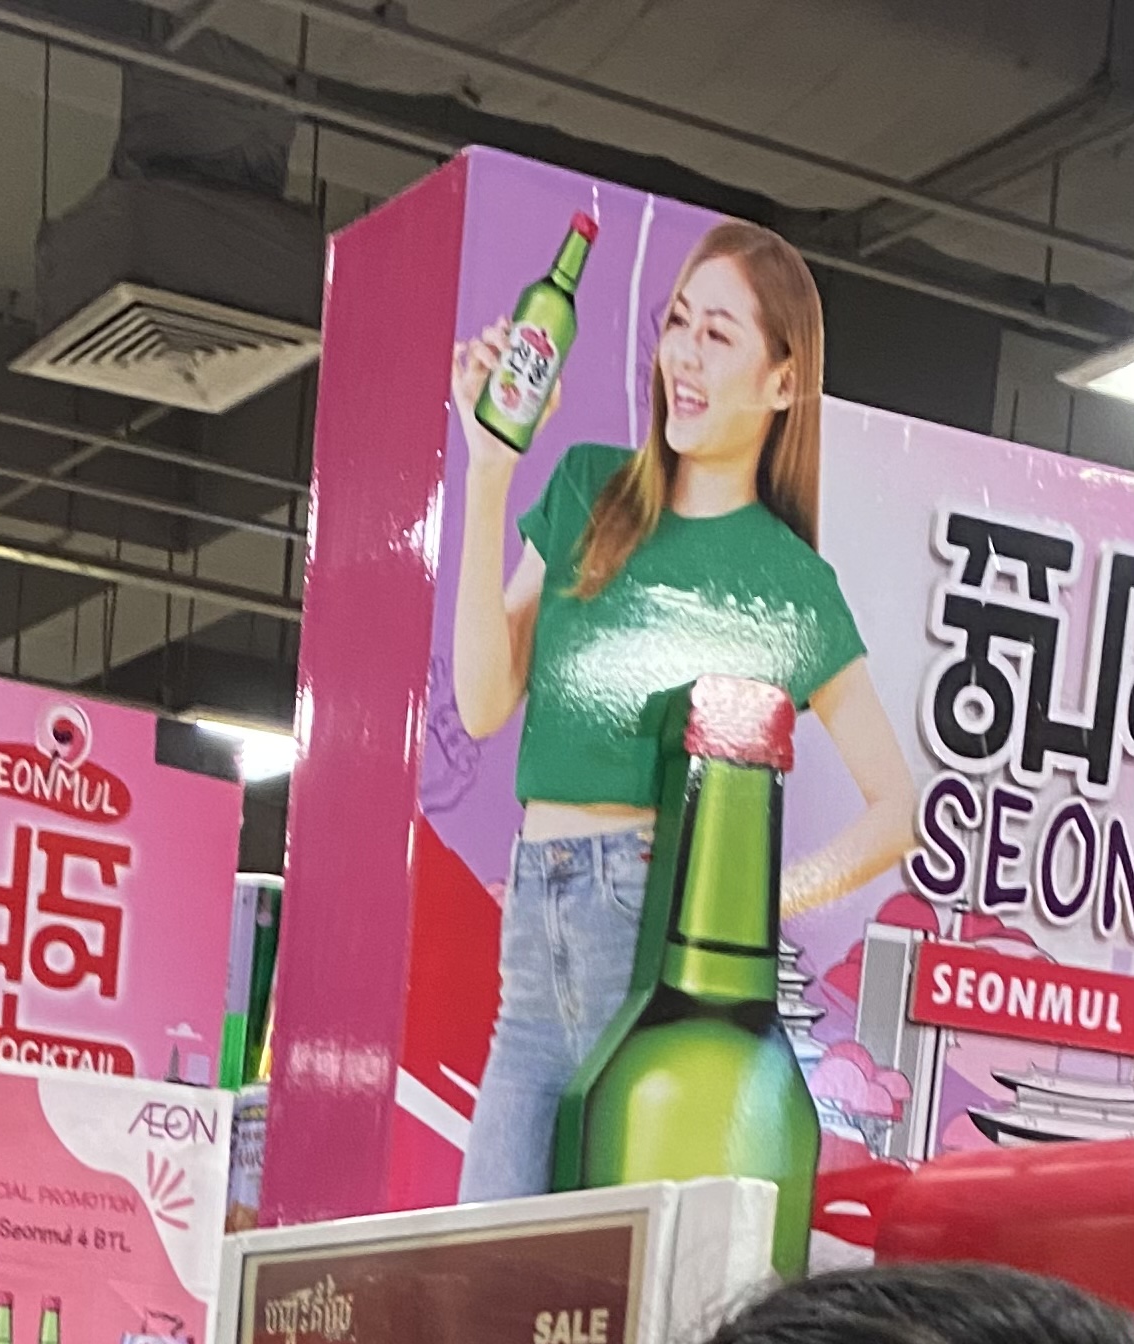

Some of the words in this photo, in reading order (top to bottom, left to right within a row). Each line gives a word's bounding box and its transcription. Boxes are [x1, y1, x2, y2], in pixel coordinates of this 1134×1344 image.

[931, 962, 1123, 1034] SEONMUL
[38, 1186, 139, 1217] PROMOTION
[94, 1231, 132, 1253] BTL
